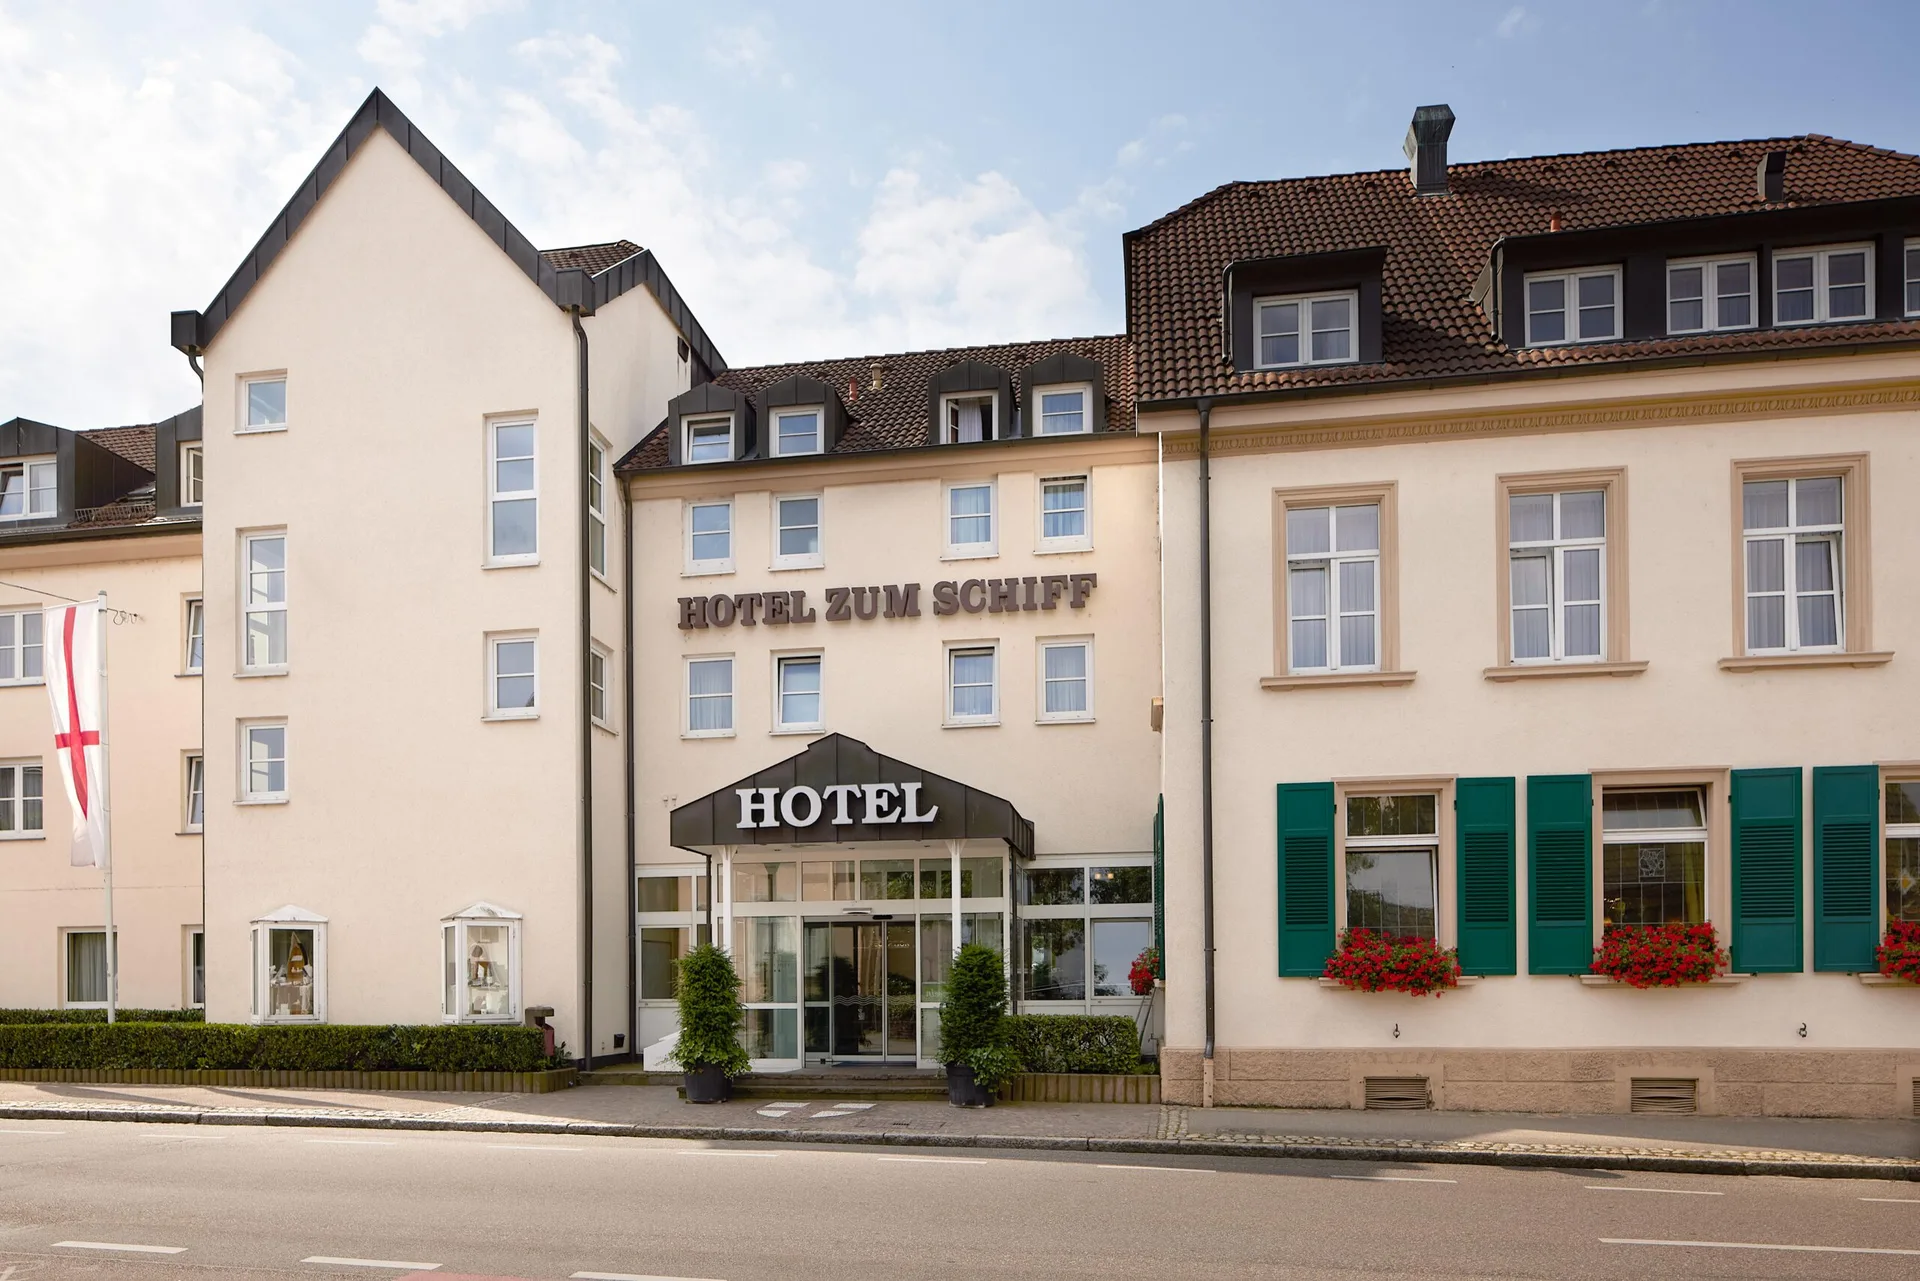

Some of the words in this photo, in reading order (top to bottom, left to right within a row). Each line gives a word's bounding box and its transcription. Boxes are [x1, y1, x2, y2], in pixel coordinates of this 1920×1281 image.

[677, 590, 816, 630] HOTEL
[825, 583, 921, 622] ZUM
[933, 573, 1097, 616] SCHIFF
[735, 782, 939, 829] HOTEL
